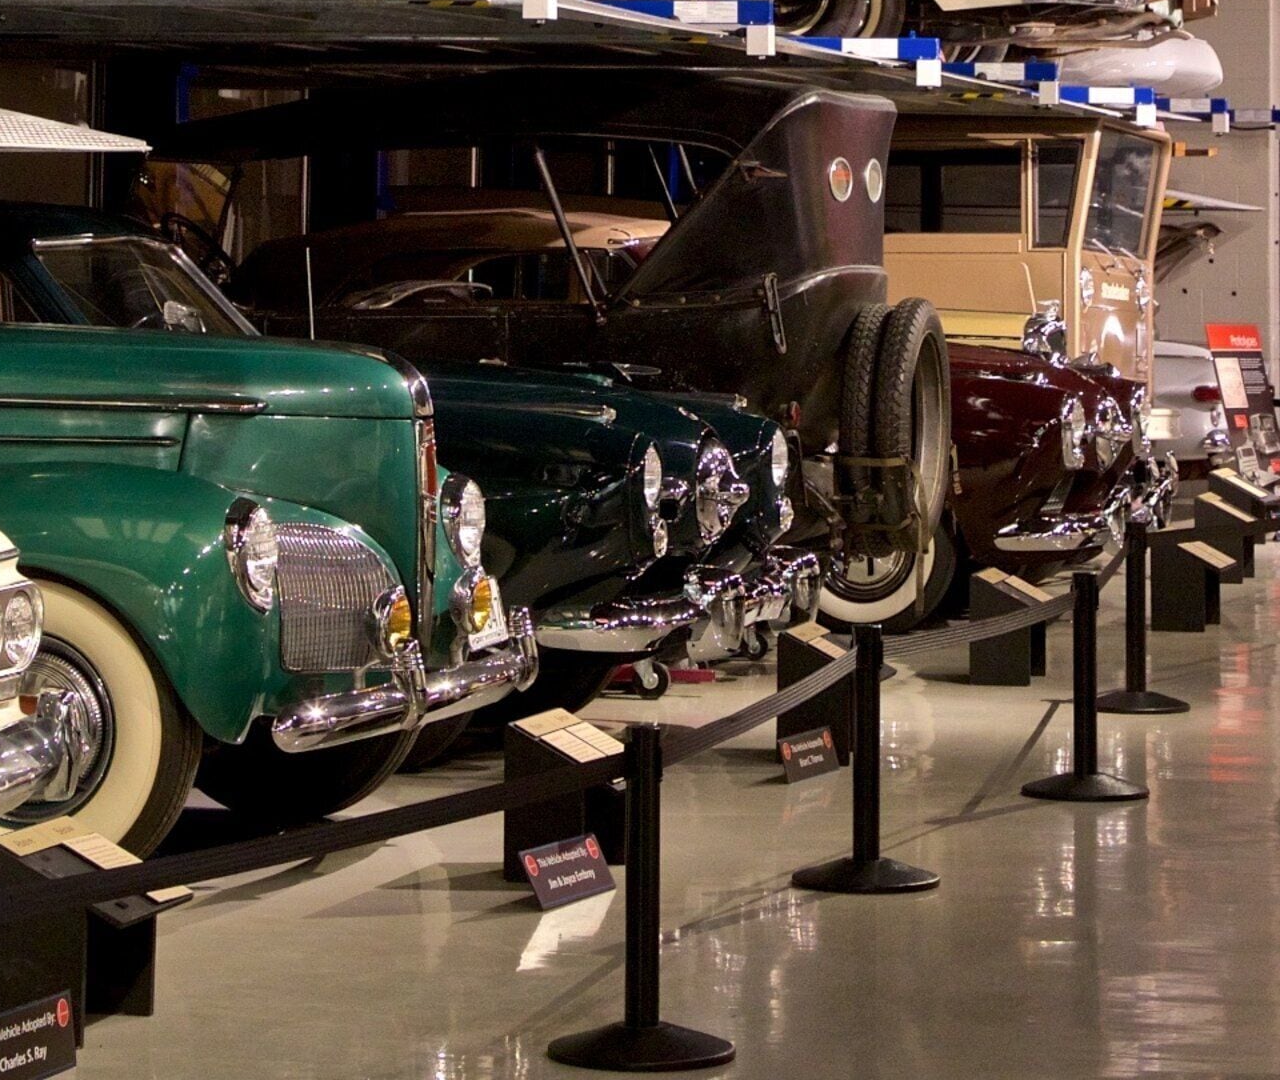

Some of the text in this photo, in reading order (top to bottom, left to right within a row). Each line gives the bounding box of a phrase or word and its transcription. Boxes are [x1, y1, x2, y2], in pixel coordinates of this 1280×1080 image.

[22, 1013, 47, 1032] Adopted
[0, 1052, 26, 1072] Charles
[34, 1046, 48, 1060] Ray
